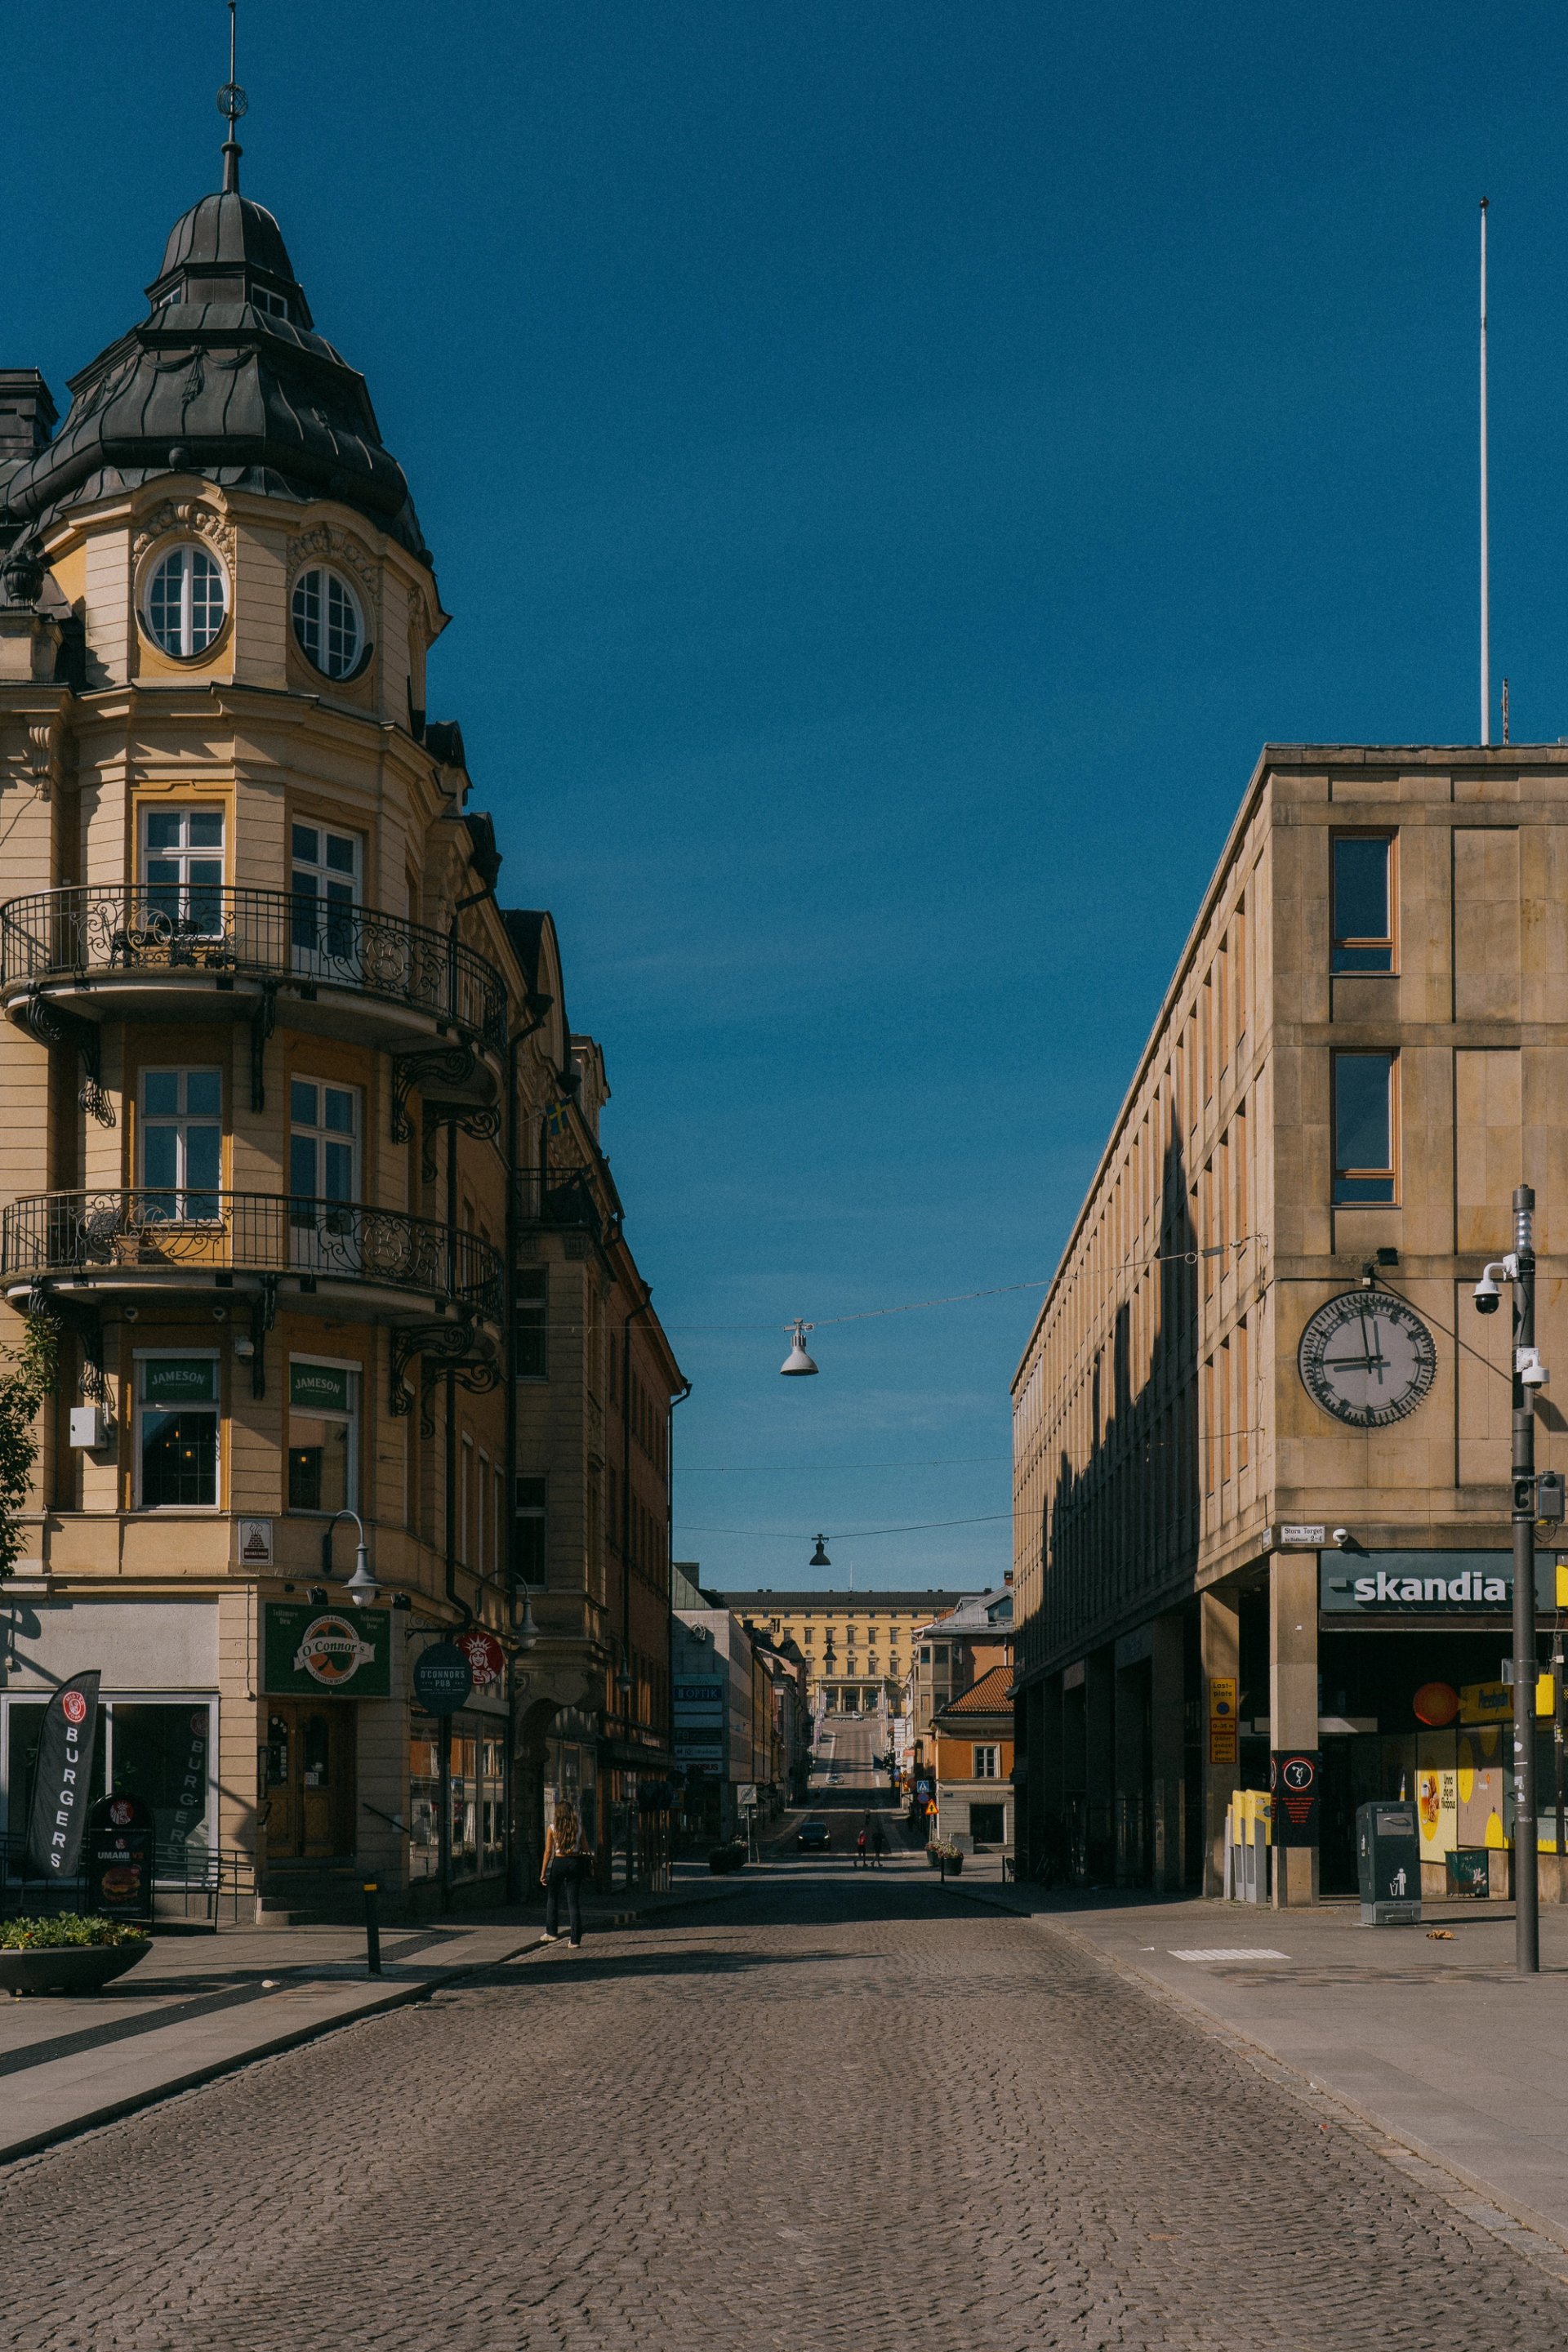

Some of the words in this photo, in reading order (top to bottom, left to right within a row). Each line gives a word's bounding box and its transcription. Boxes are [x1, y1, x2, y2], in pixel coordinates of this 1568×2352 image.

[151, 1371, 206, 1385] JAMESON
[296, 1378, 341, 1394] JAMESON
[1354, 1571, 1506, 1601] skandia
[686, 1688, 719, 1699] OPTIK
[51, 1726, 79, 1868] BURGERS
[98, 1851, 130, 1860] UMAMI
